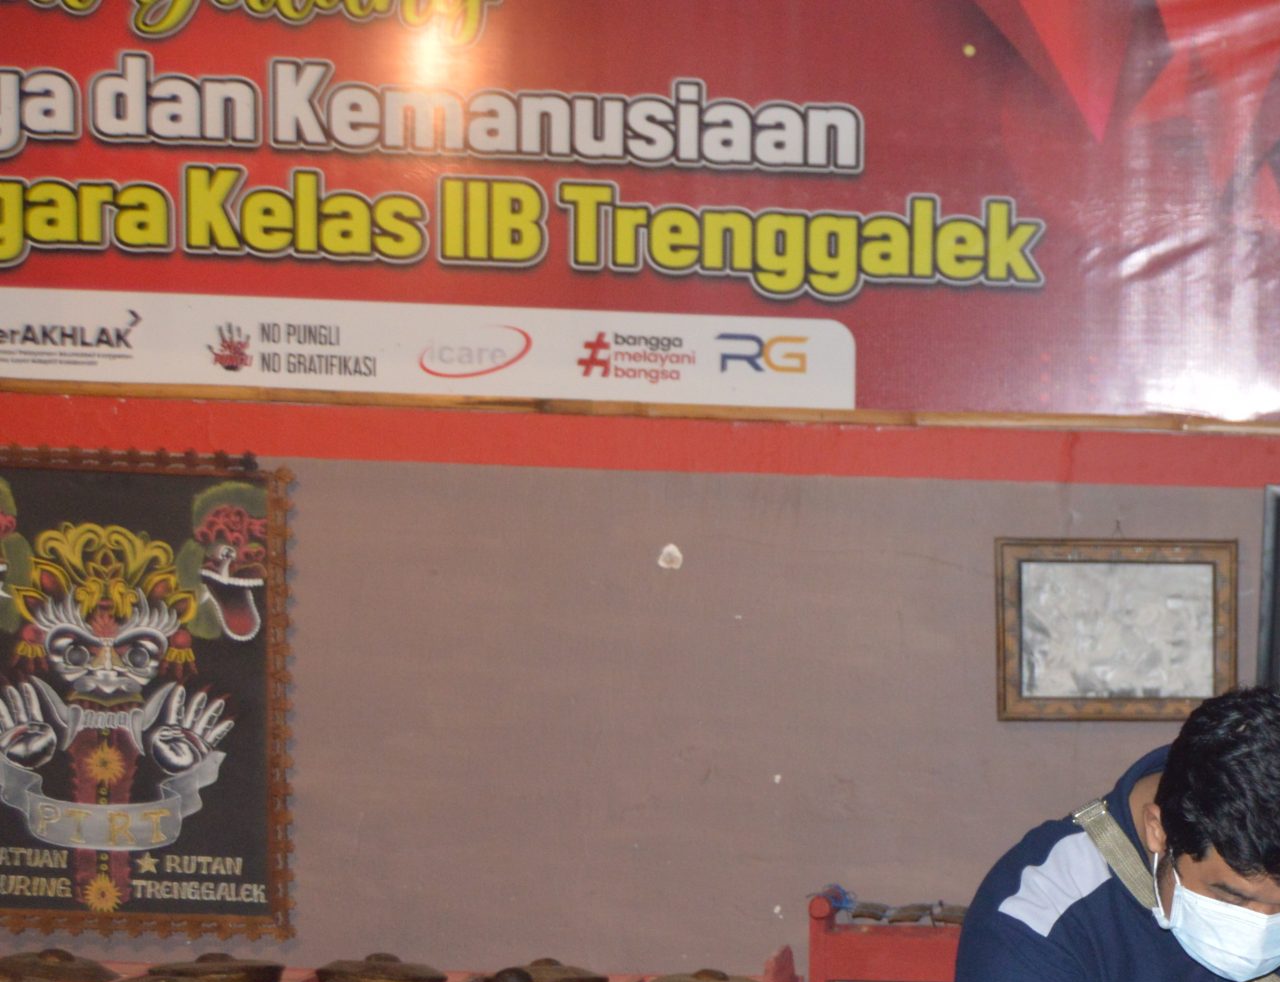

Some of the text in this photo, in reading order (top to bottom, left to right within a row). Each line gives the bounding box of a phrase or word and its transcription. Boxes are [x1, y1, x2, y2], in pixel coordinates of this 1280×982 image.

[91, 51, 261, 146] dan
[272, 59, 863, 172] Kemanusiaan
[183, 164, 428, 262] Kelas
[438, 176, 548, 268] IIB
[558, 181, 1044, 301] Trenggalek
[258, 322, 341, 347] NO PUNGLI
[613, 333, 683, 350] bangga
[259, 351, 281, 374] NO
[286, 353, 378, 378] GRATIFIKASI
[427, 339, 509, 366] icare
[613, 350, 696, 367] melayani
[714, 333, 809, 374] RG
[613, 366, 681, 384] bangsa
[164, 854, 244, 876] RUTAN
[132, 879, 268, 904] TRENGGALEK
